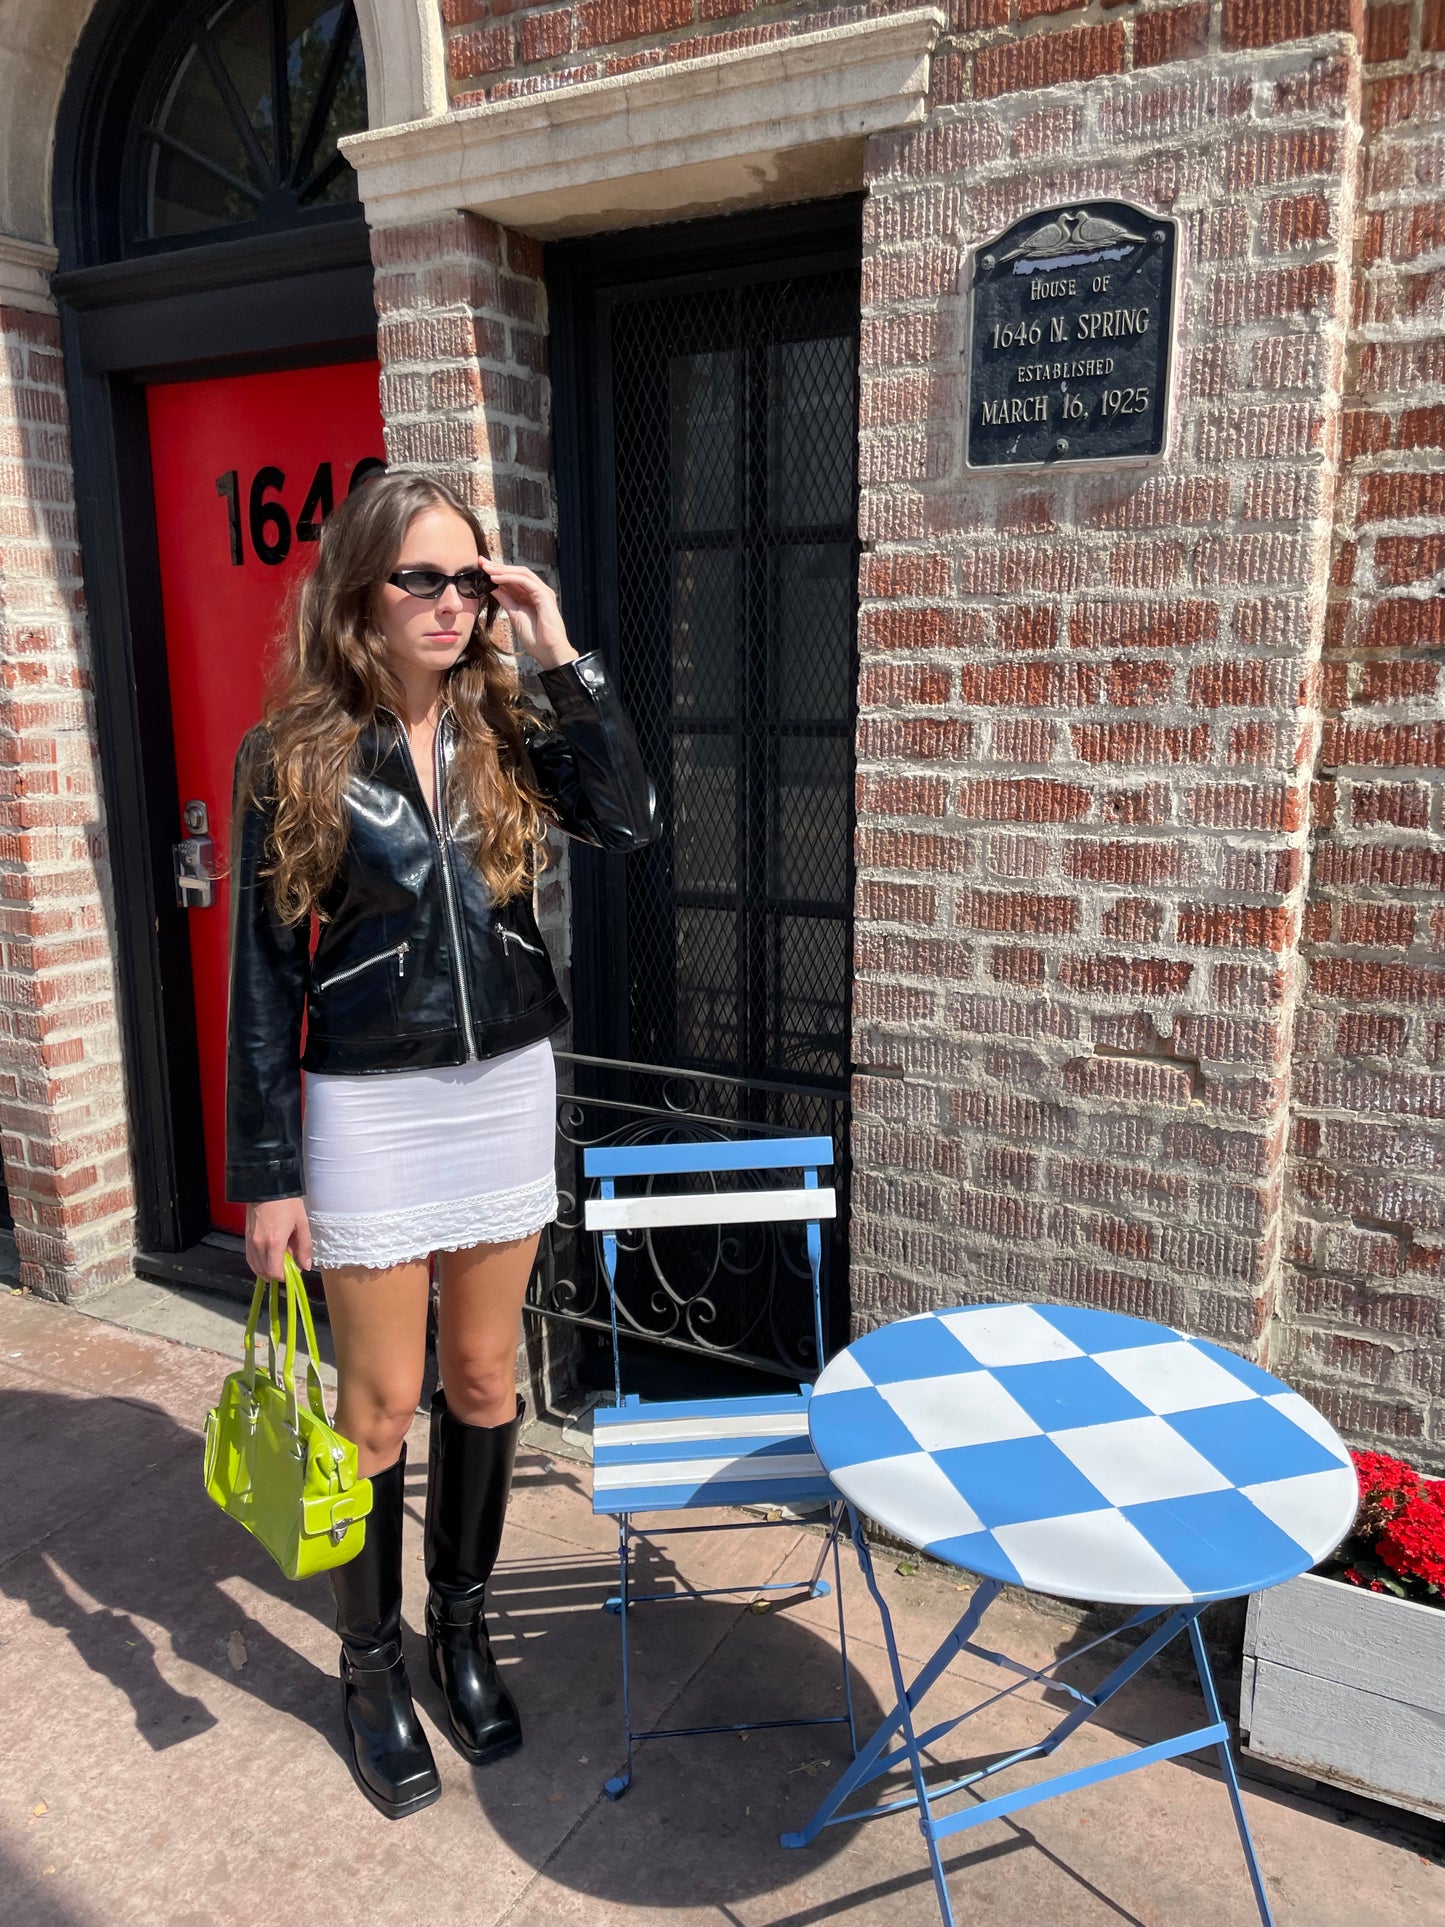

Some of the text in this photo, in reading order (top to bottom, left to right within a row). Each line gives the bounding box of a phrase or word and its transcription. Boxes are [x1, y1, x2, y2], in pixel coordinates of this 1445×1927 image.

[1092, 275, 1111, 293] OF
[993, 308, 1149, 349] 1646 N. SPRING
[1018, 358, 1114, 383] ESTABLISHED
[981, 388, 1149, 426] MARCH 16, 1925
[216, 457, 388, 566] 164
